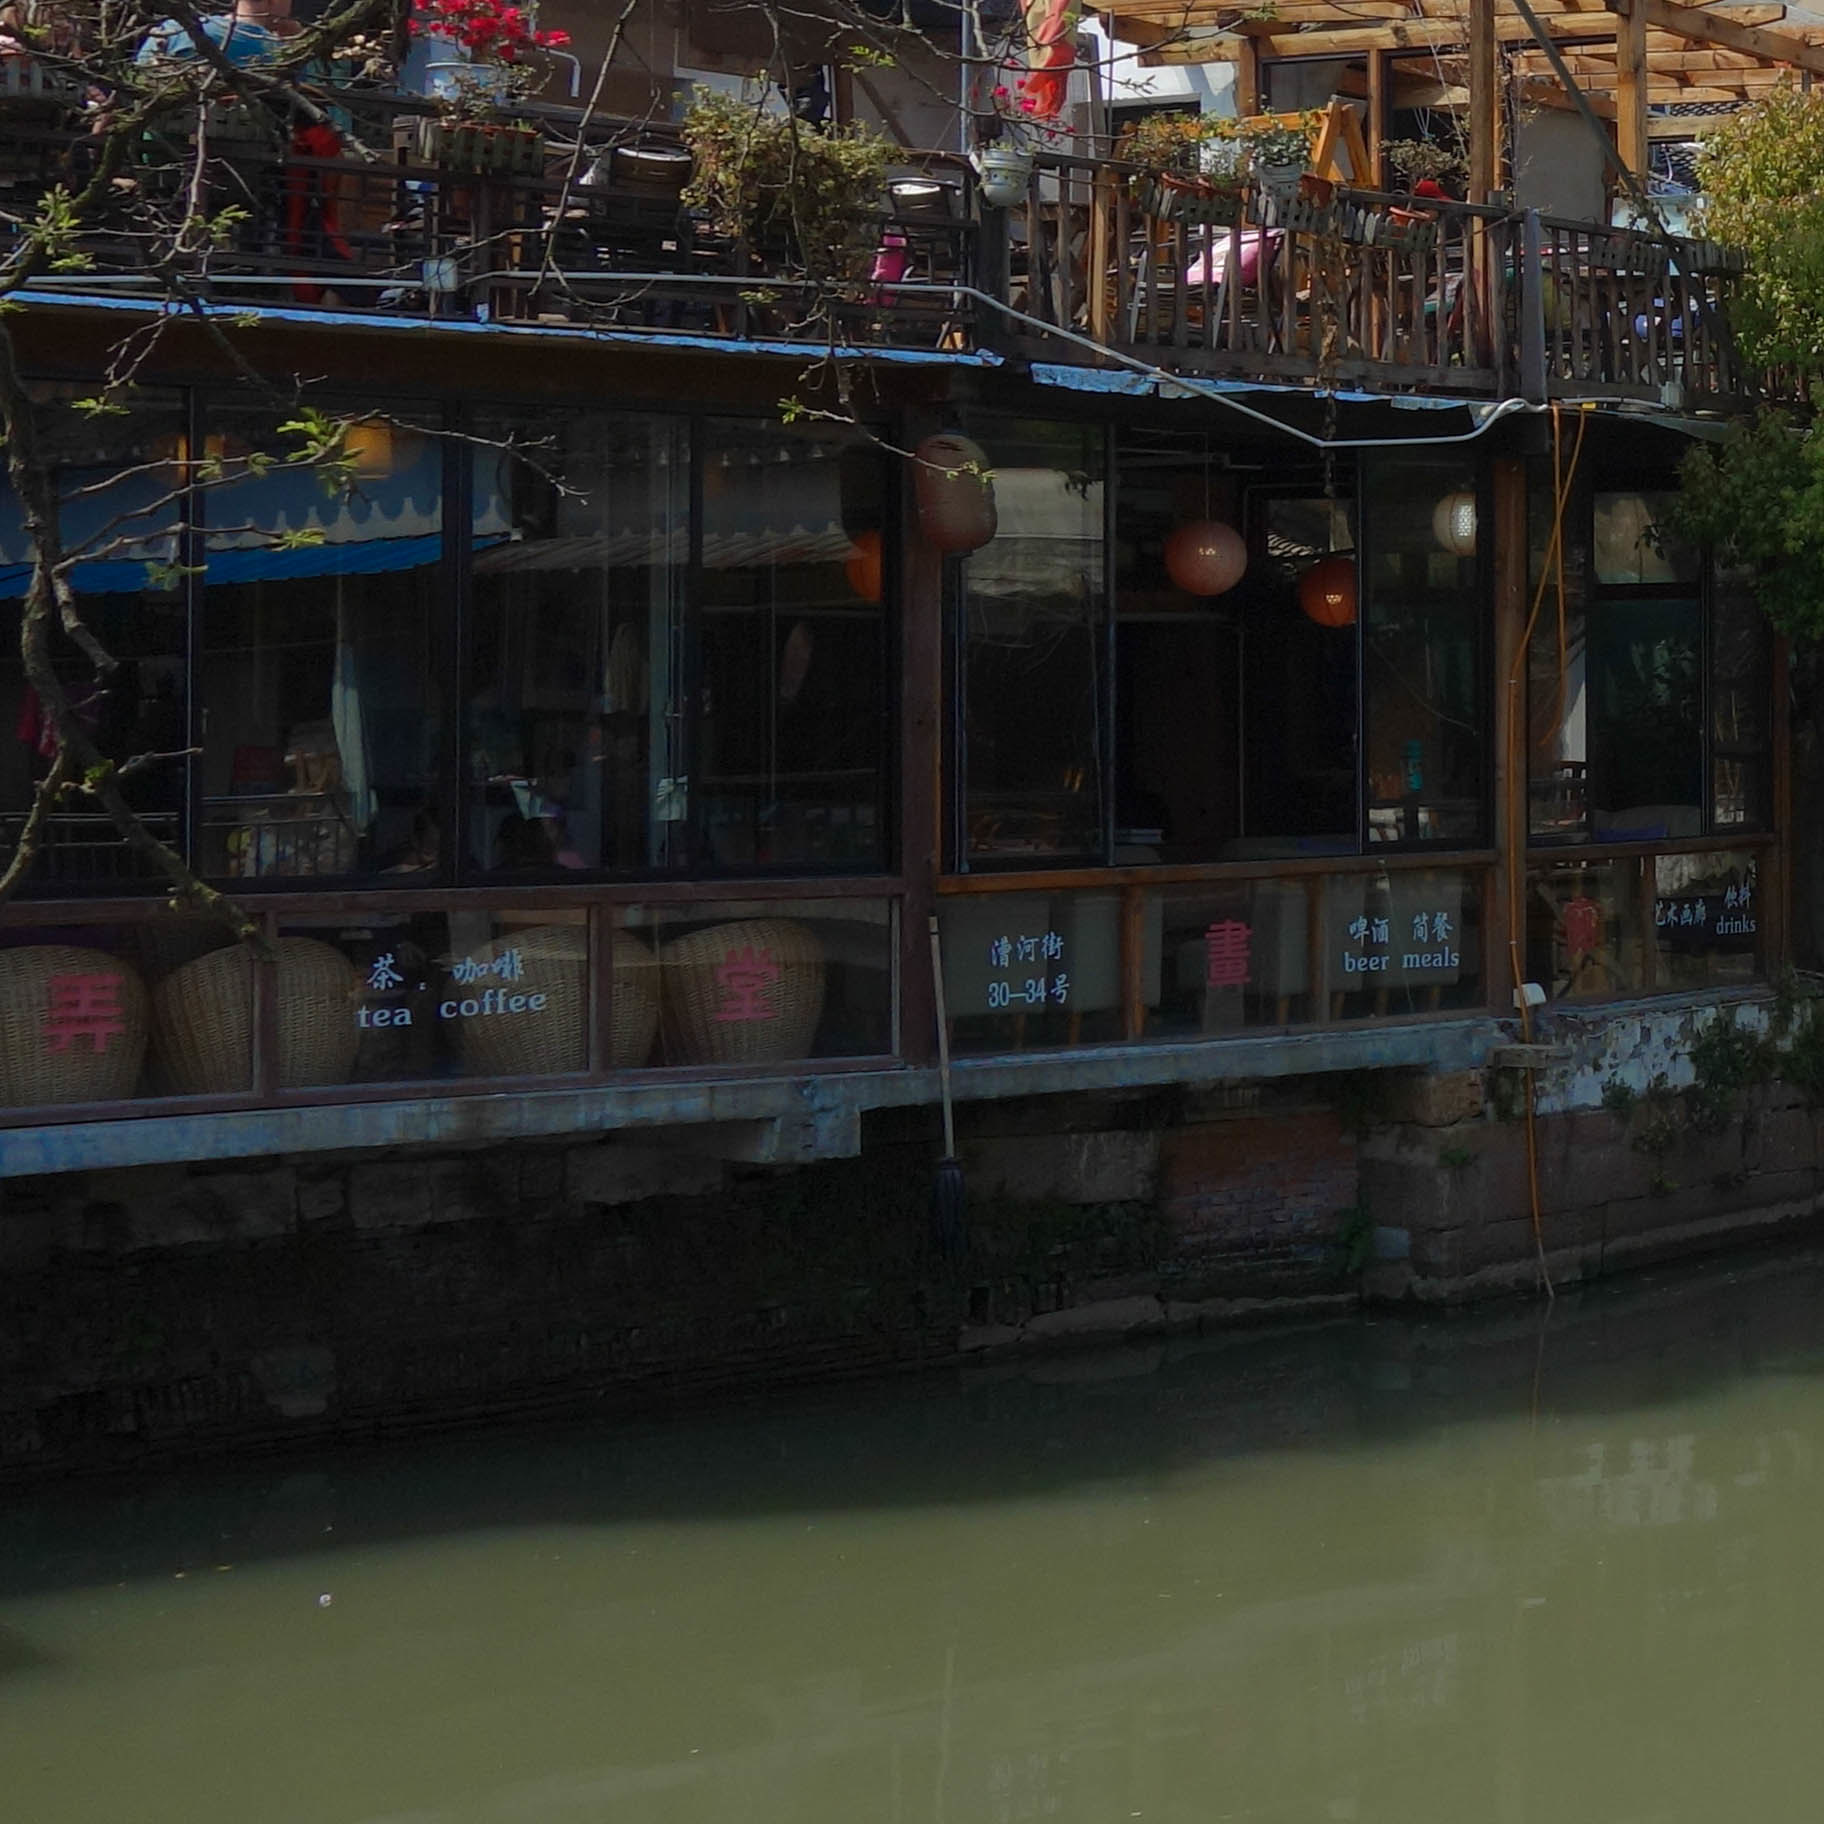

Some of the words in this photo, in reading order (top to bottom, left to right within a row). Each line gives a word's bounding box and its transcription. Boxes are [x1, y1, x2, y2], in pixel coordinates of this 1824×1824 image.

[1349, 915, 1391, 948] 啤酒
[1412, 912, 1454, 943] 简餐
[1716, 915, 1757, 935] drinks
[367, 952, 404, 990] 茶
[452, 948, 525, 986] 咖啡
[1344, 951, 1390, 972] beer
[1402, 946, 1460, 969] meals
[714, 945, 781, 1022] 堂
[43, 971, 127, 1055] 弄
[357, 1004, 413, 1028] tea
[439, 988, 547, 1019] coffee
